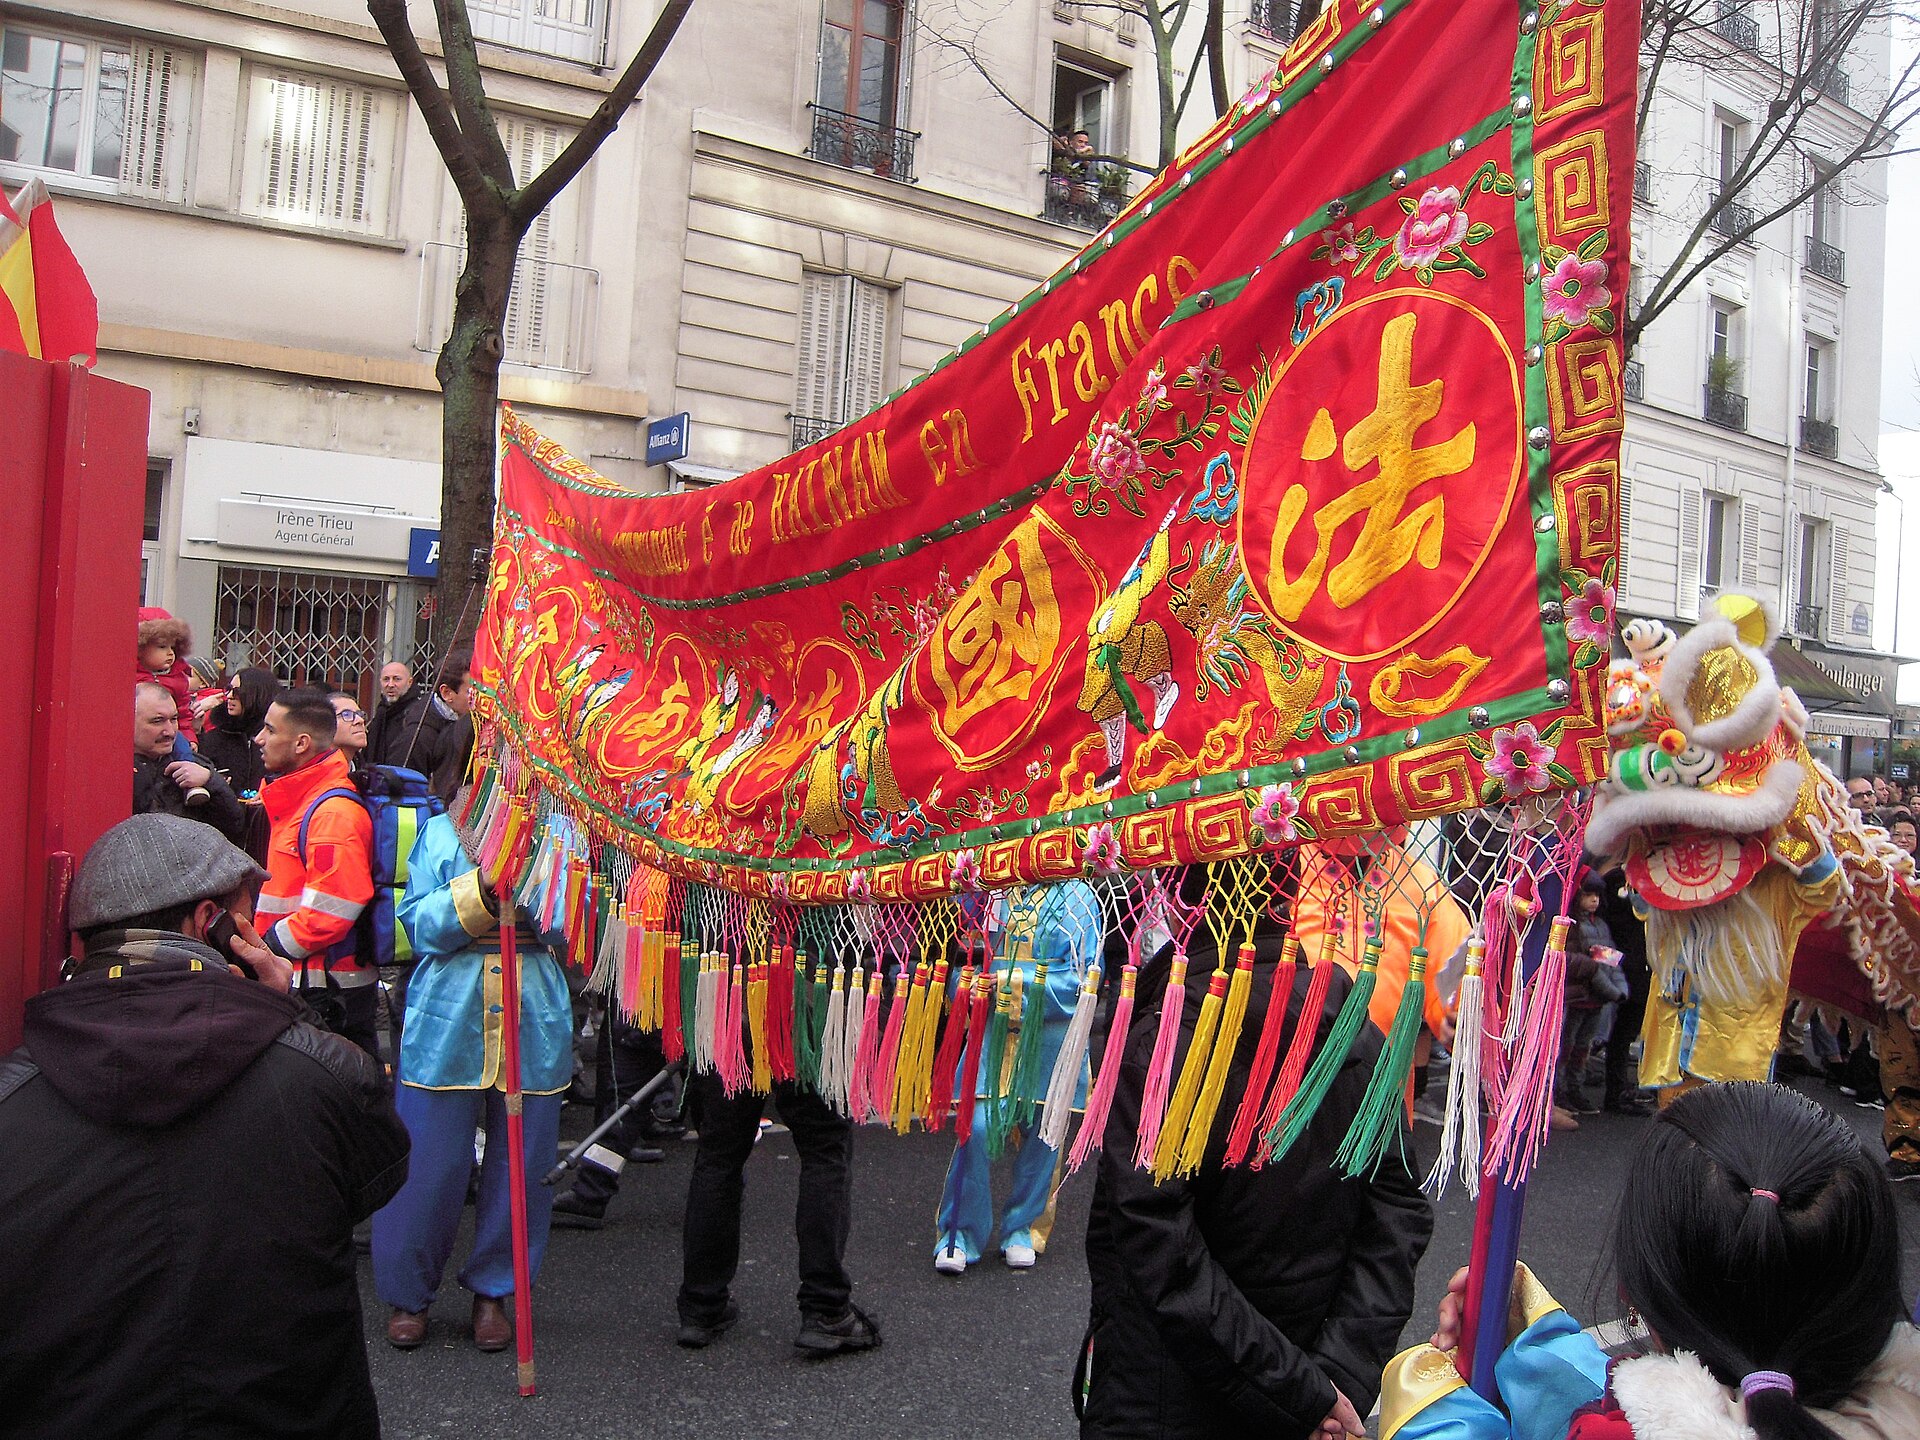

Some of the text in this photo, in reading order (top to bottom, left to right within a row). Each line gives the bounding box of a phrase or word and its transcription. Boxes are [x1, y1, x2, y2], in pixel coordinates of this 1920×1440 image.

[648, 434, 671, 449] Allianz
[919, 408, 985, 487] en
[1268, 312, 1478, 622] 法
[276, 510, 354, 531] Irène Trieu
[274, 529, 355, 547] Agent Général
